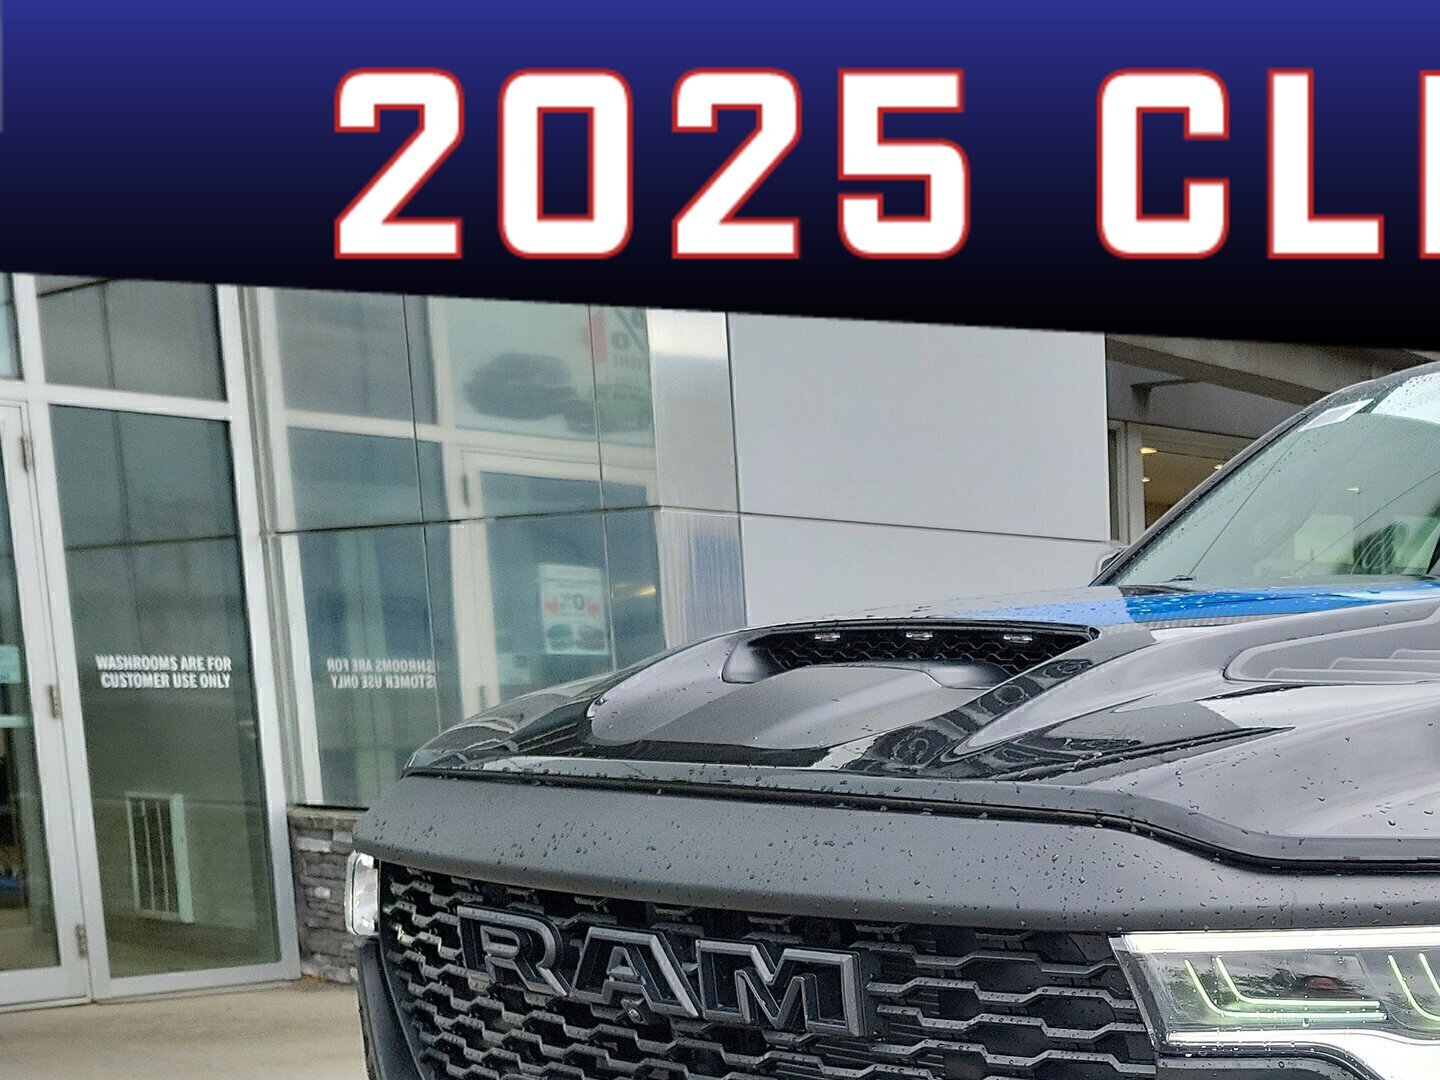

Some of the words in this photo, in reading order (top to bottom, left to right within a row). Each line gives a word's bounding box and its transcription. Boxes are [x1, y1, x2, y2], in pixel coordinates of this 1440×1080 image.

[95, 654, 178, 672] WASHROOMS
[180, 655, 206, 672] ARE
[207, 655, 232, 672] FOR
[100, 672, 170, 689] CUSTOMER
[172, 673, 198, 688] USE
[200, 673, 231, 689] ONLY
[457, 902, 866, 1038] RAM
